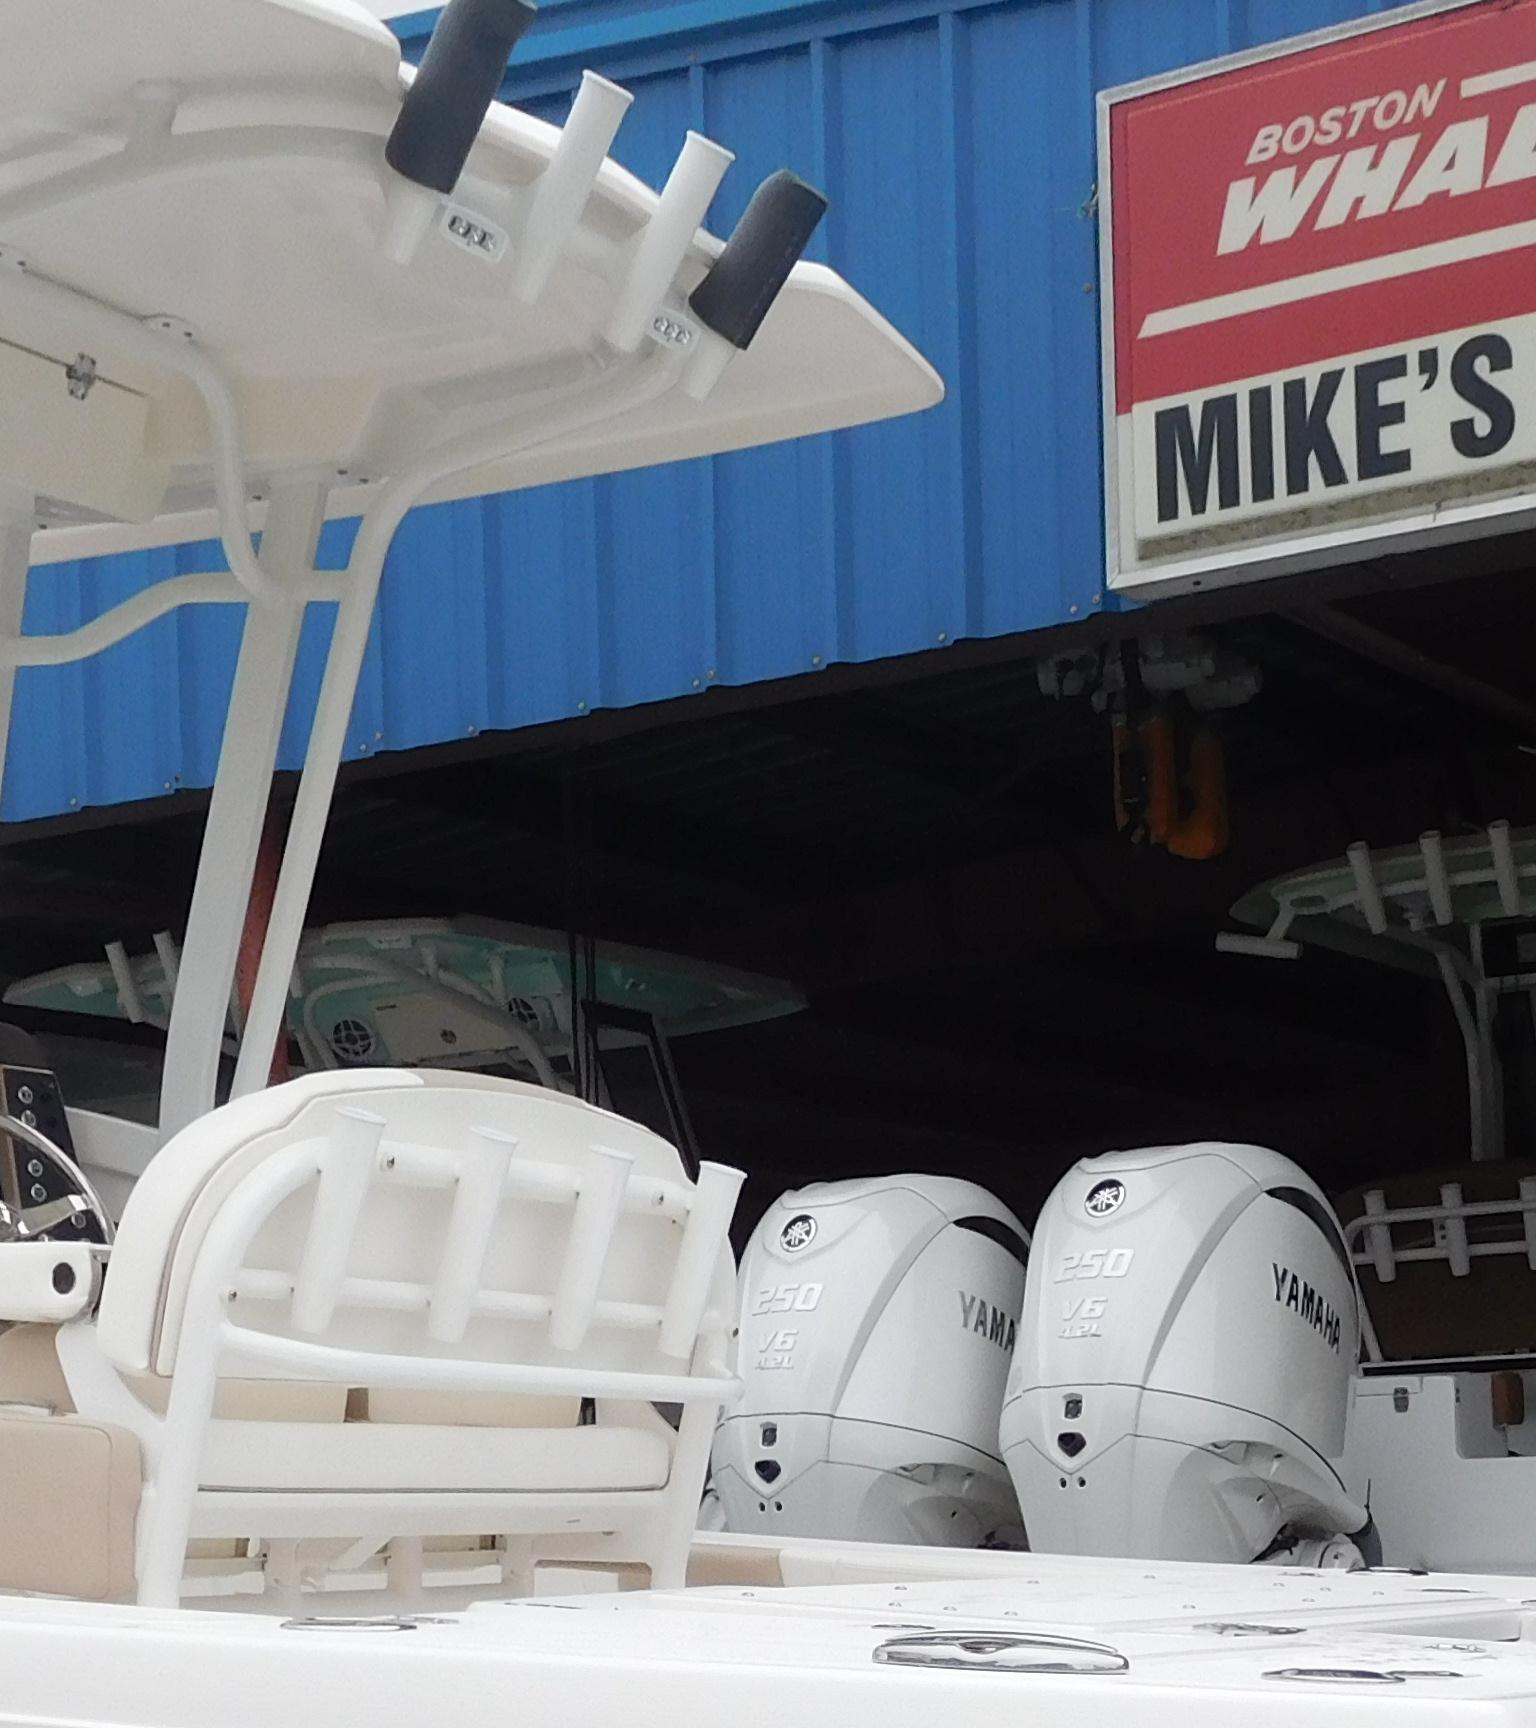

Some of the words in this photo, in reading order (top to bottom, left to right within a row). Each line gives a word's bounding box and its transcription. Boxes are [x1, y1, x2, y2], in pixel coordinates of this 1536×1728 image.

[1245, 79, 1446, 165] BOSTON
[1156, 333, 1515, 523] MIKE'S
[1052, 1248, 1135, 1284] 250
[751, 1282, 824, 1316] 250
[958, 1290, 1016, 1353] YAMA
[1063, 1296, 1109, 1322] V6
[1272, 1262, 1342, 1355] YAMAHA
